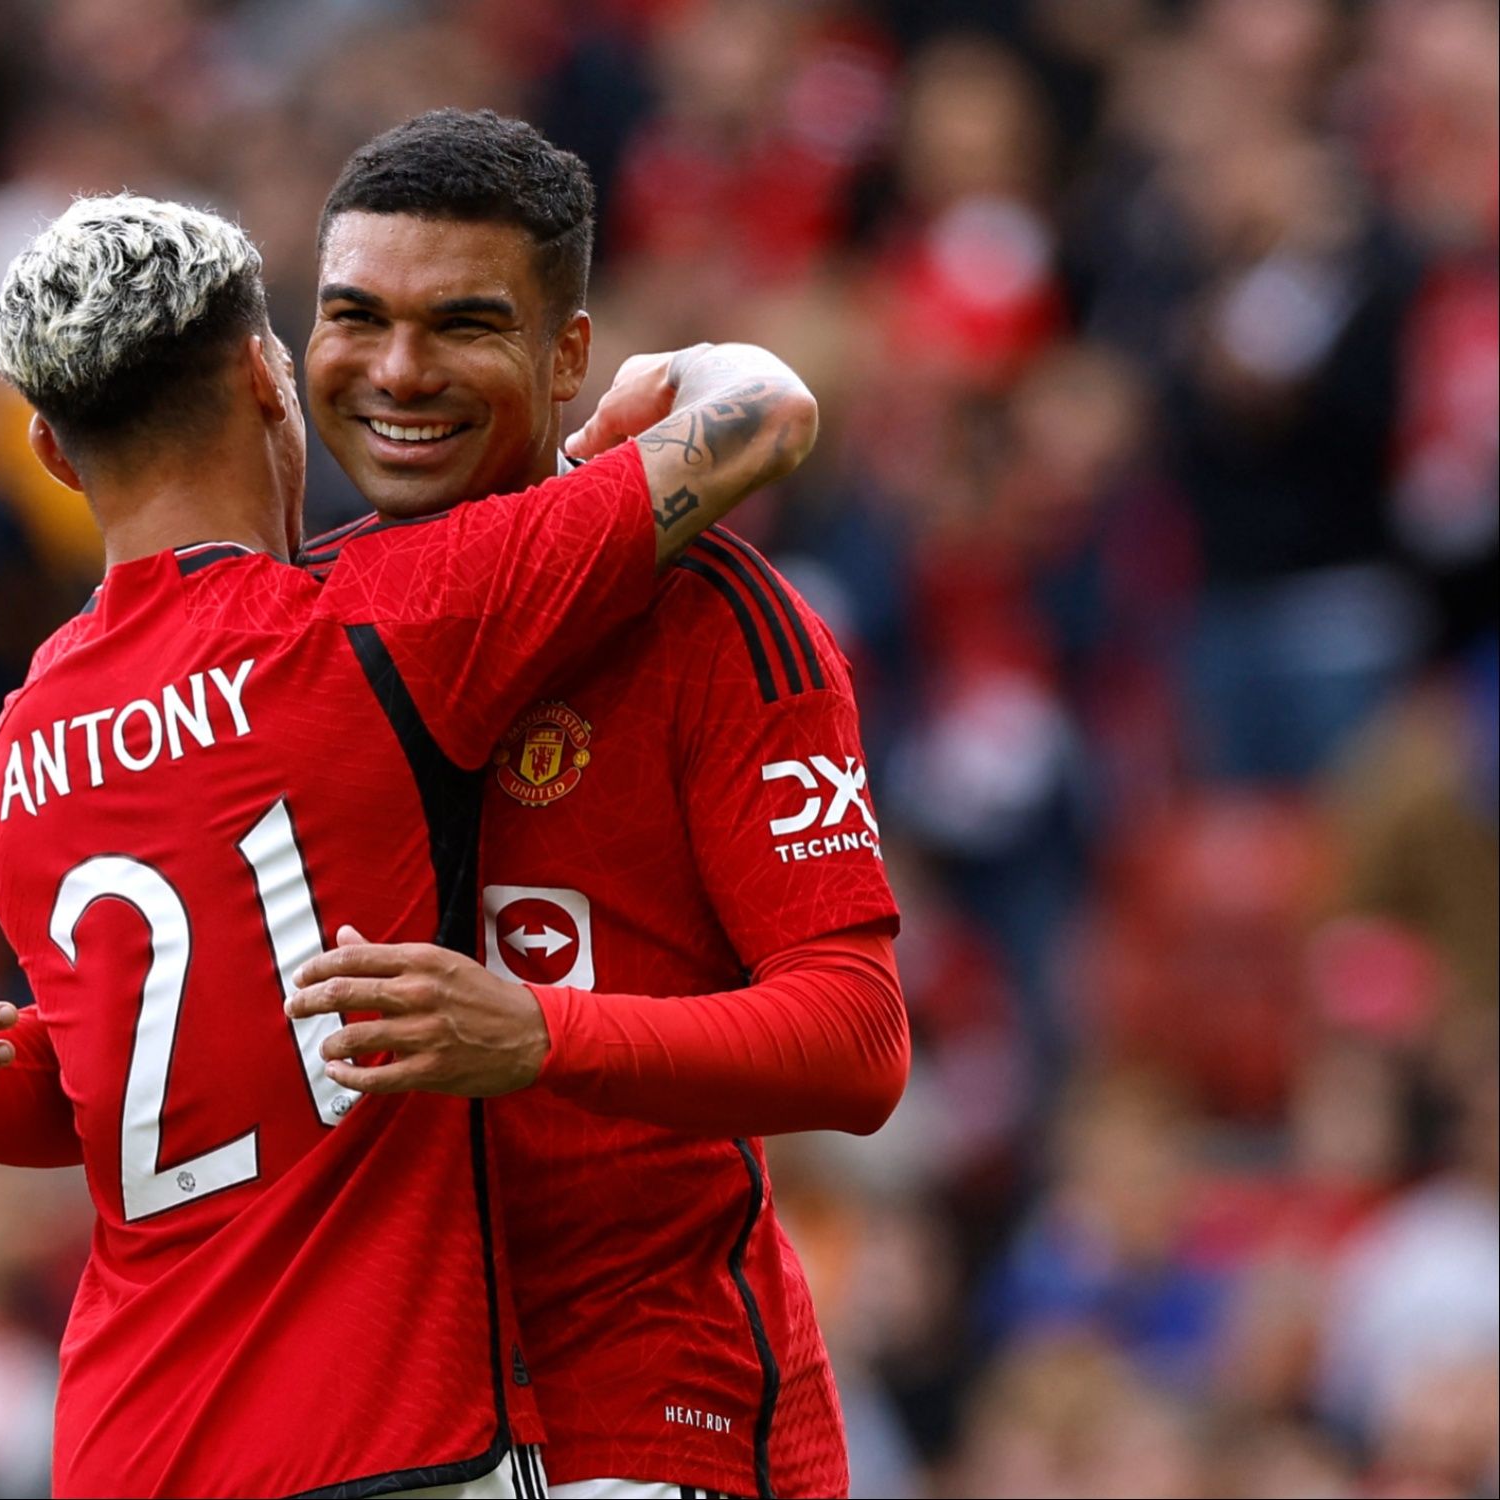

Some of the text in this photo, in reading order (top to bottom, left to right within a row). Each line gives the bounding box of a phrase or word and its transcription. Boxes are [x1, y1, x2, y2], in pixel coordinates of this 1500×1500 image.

[0, 659, 255, 821] ANTONY
[505, 707, 585, 745] MANCHESTER
[509, 781, 565, 799] UNITED
[49, 795, 362, 1222] 21
[665, 1406, 731, 1434] HEAT.RDY
